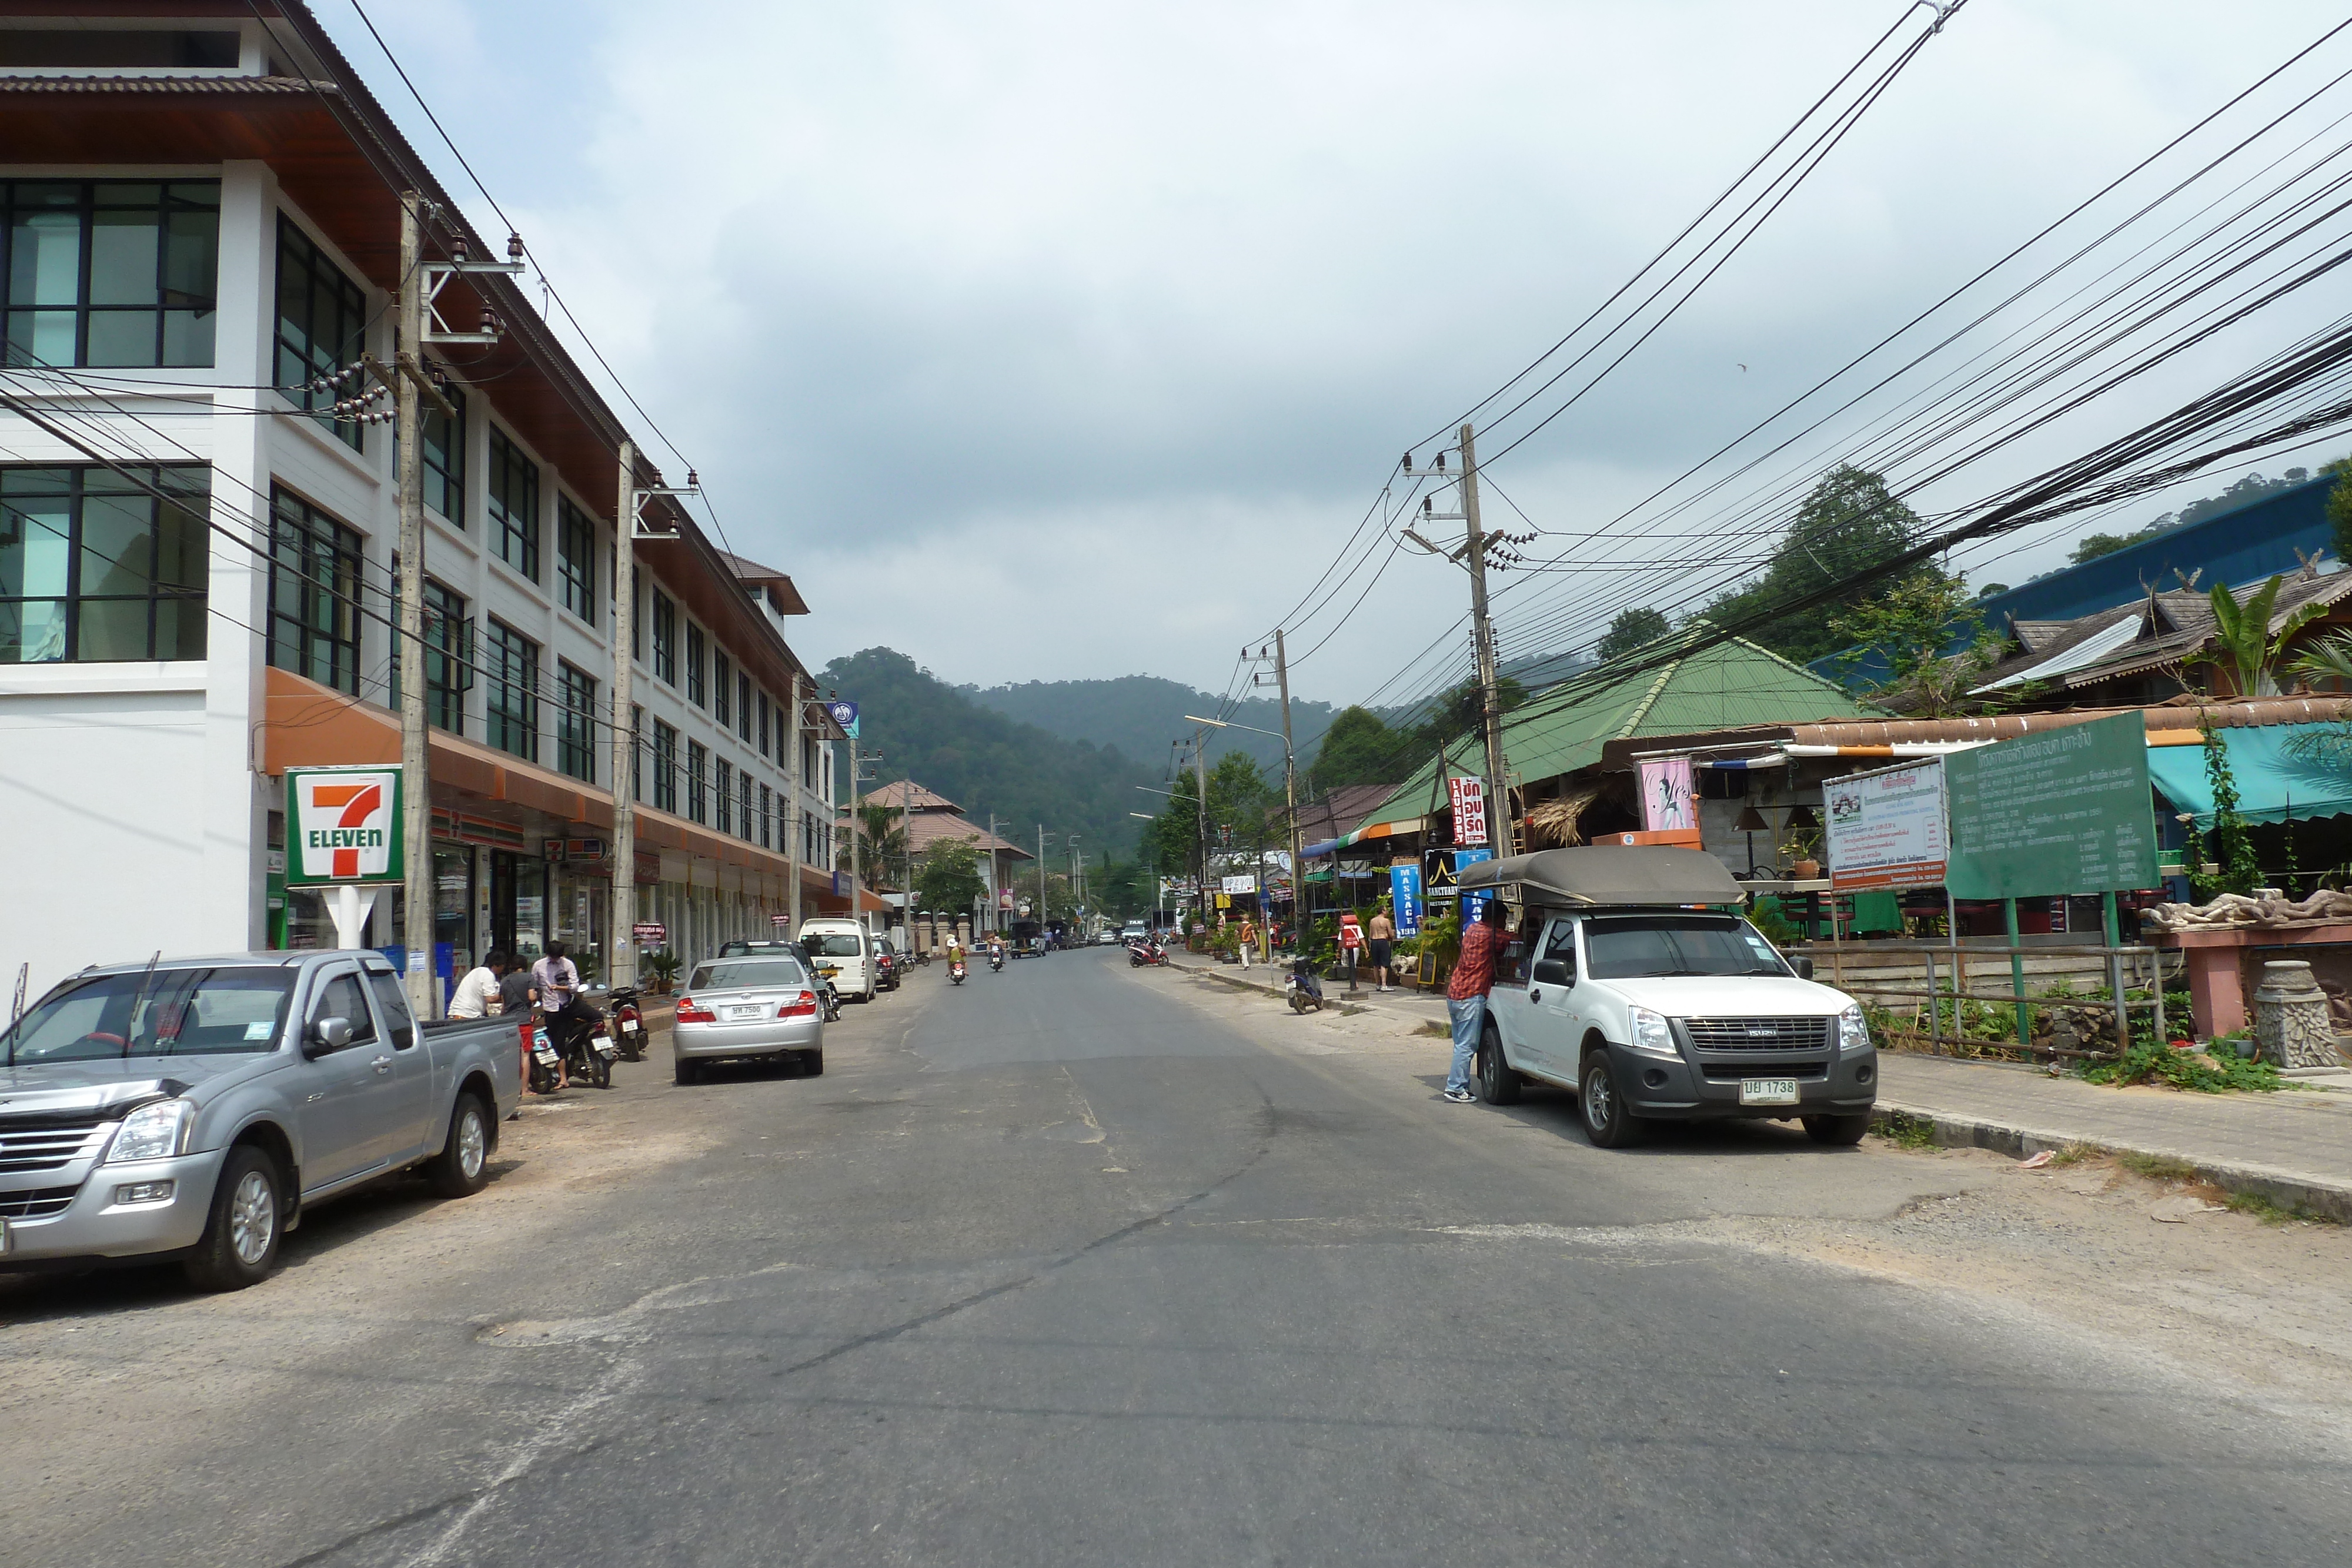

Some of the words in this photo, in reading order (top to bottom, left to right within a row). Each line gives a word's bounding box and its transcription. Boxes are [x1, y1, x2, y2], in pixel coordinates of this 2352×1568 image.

[1463, 779, 1480, 797] ซัก
[1452, 780, 1464, 842] LAUNDRY
[1465, 801, 1482, 814] อบ
[313, 784, 380, 876] 7
[1466, 815, 1484, 832] รีด
[1400, 870, 1413, 924] MASSAGE
[1428, 886, 1458, 896] SANCTUARY
[1745, 1082, 1761, 1094] บย
[1767, 1082, 1794, 1094] 1738
